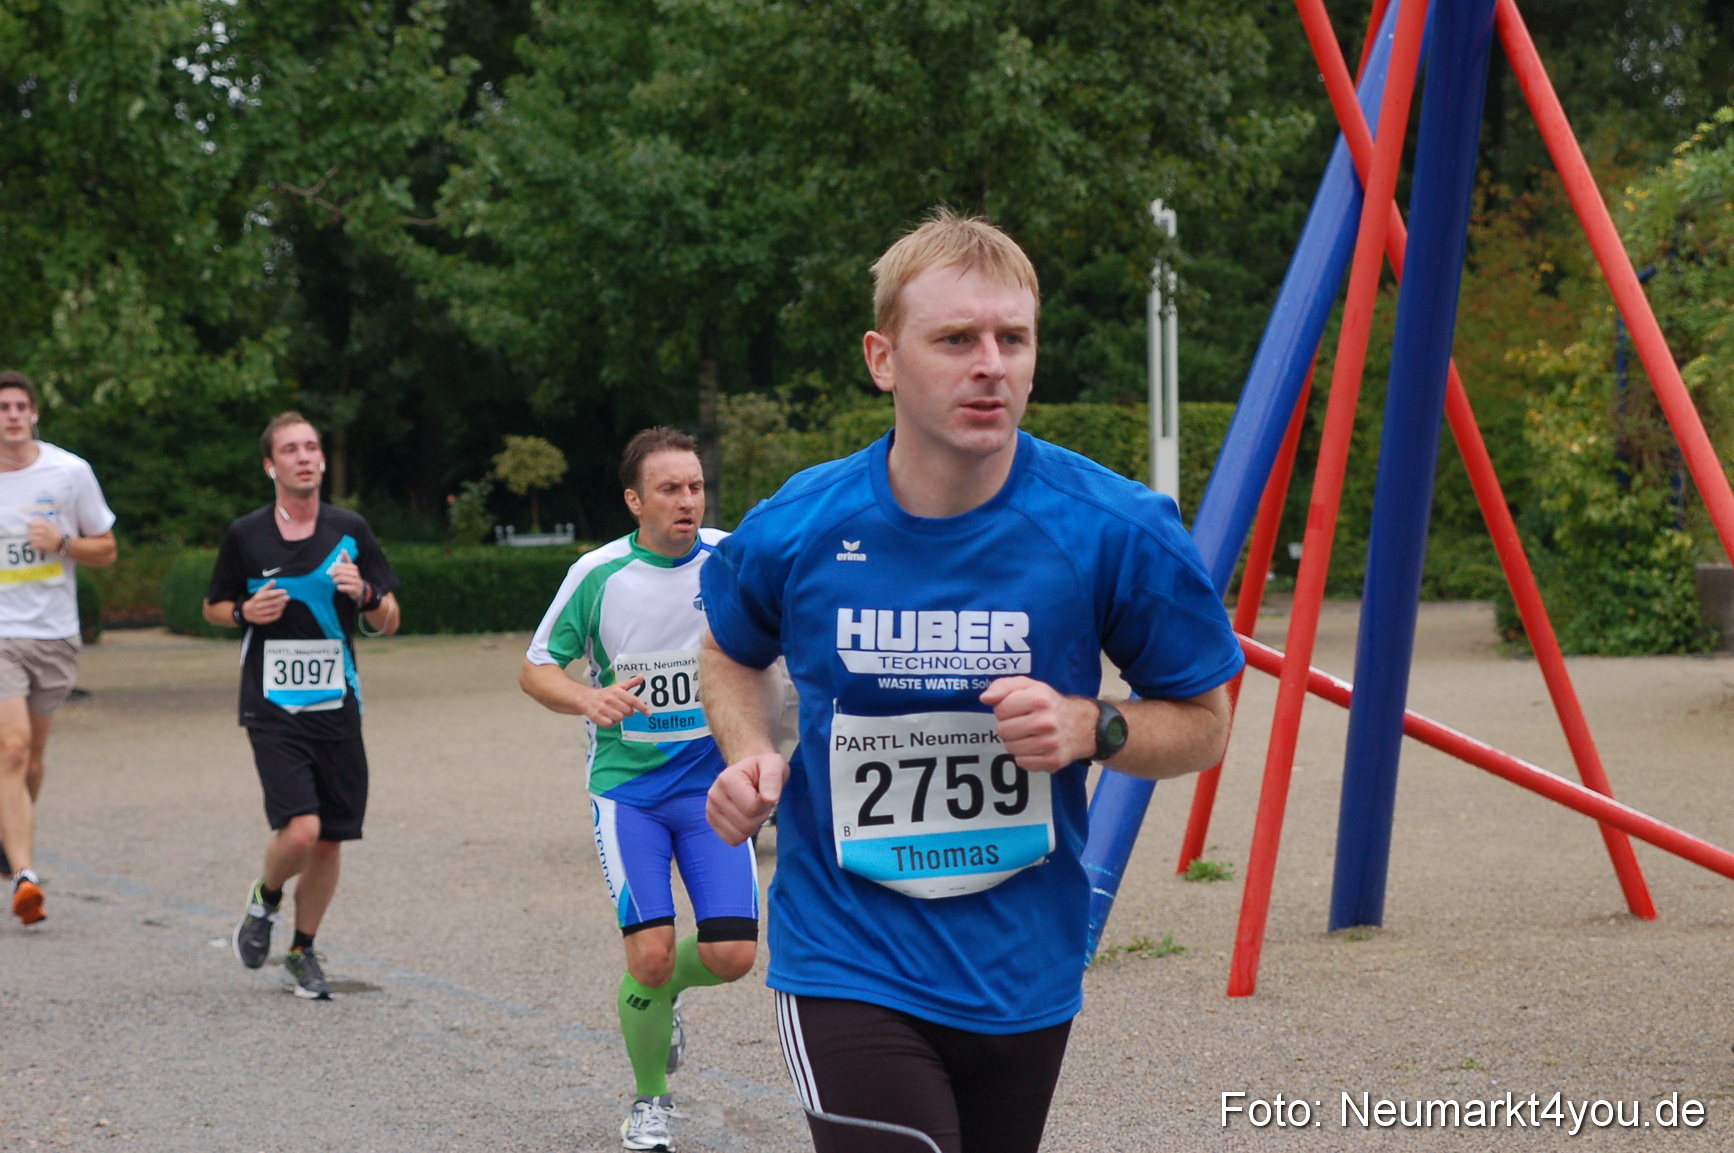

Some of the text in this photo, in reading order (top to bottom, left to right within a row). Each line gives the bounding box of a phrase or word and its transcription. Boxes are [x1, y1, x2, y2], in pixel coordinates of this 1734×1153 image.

[8, 542, 46, 565] 56
[836, 552, 867, 562] erima
[836, 608, 1031, 652] HUBER
[274, 659, 336, 685] 3097
[616, 662, 651, 672] PARTL
[878, 656, 1022, 671] TECHNOLOGY
[878, 677, 992, 690] WASTE WATER Sol
[648, 714, 696, 730] Steffen
[835, 730, 1004, 752] PARTL Neumark
[855, 753, 1030, 828] 2759
[843, 825, 851, 837] B
[891, 844, 1000, 872] Thomas
